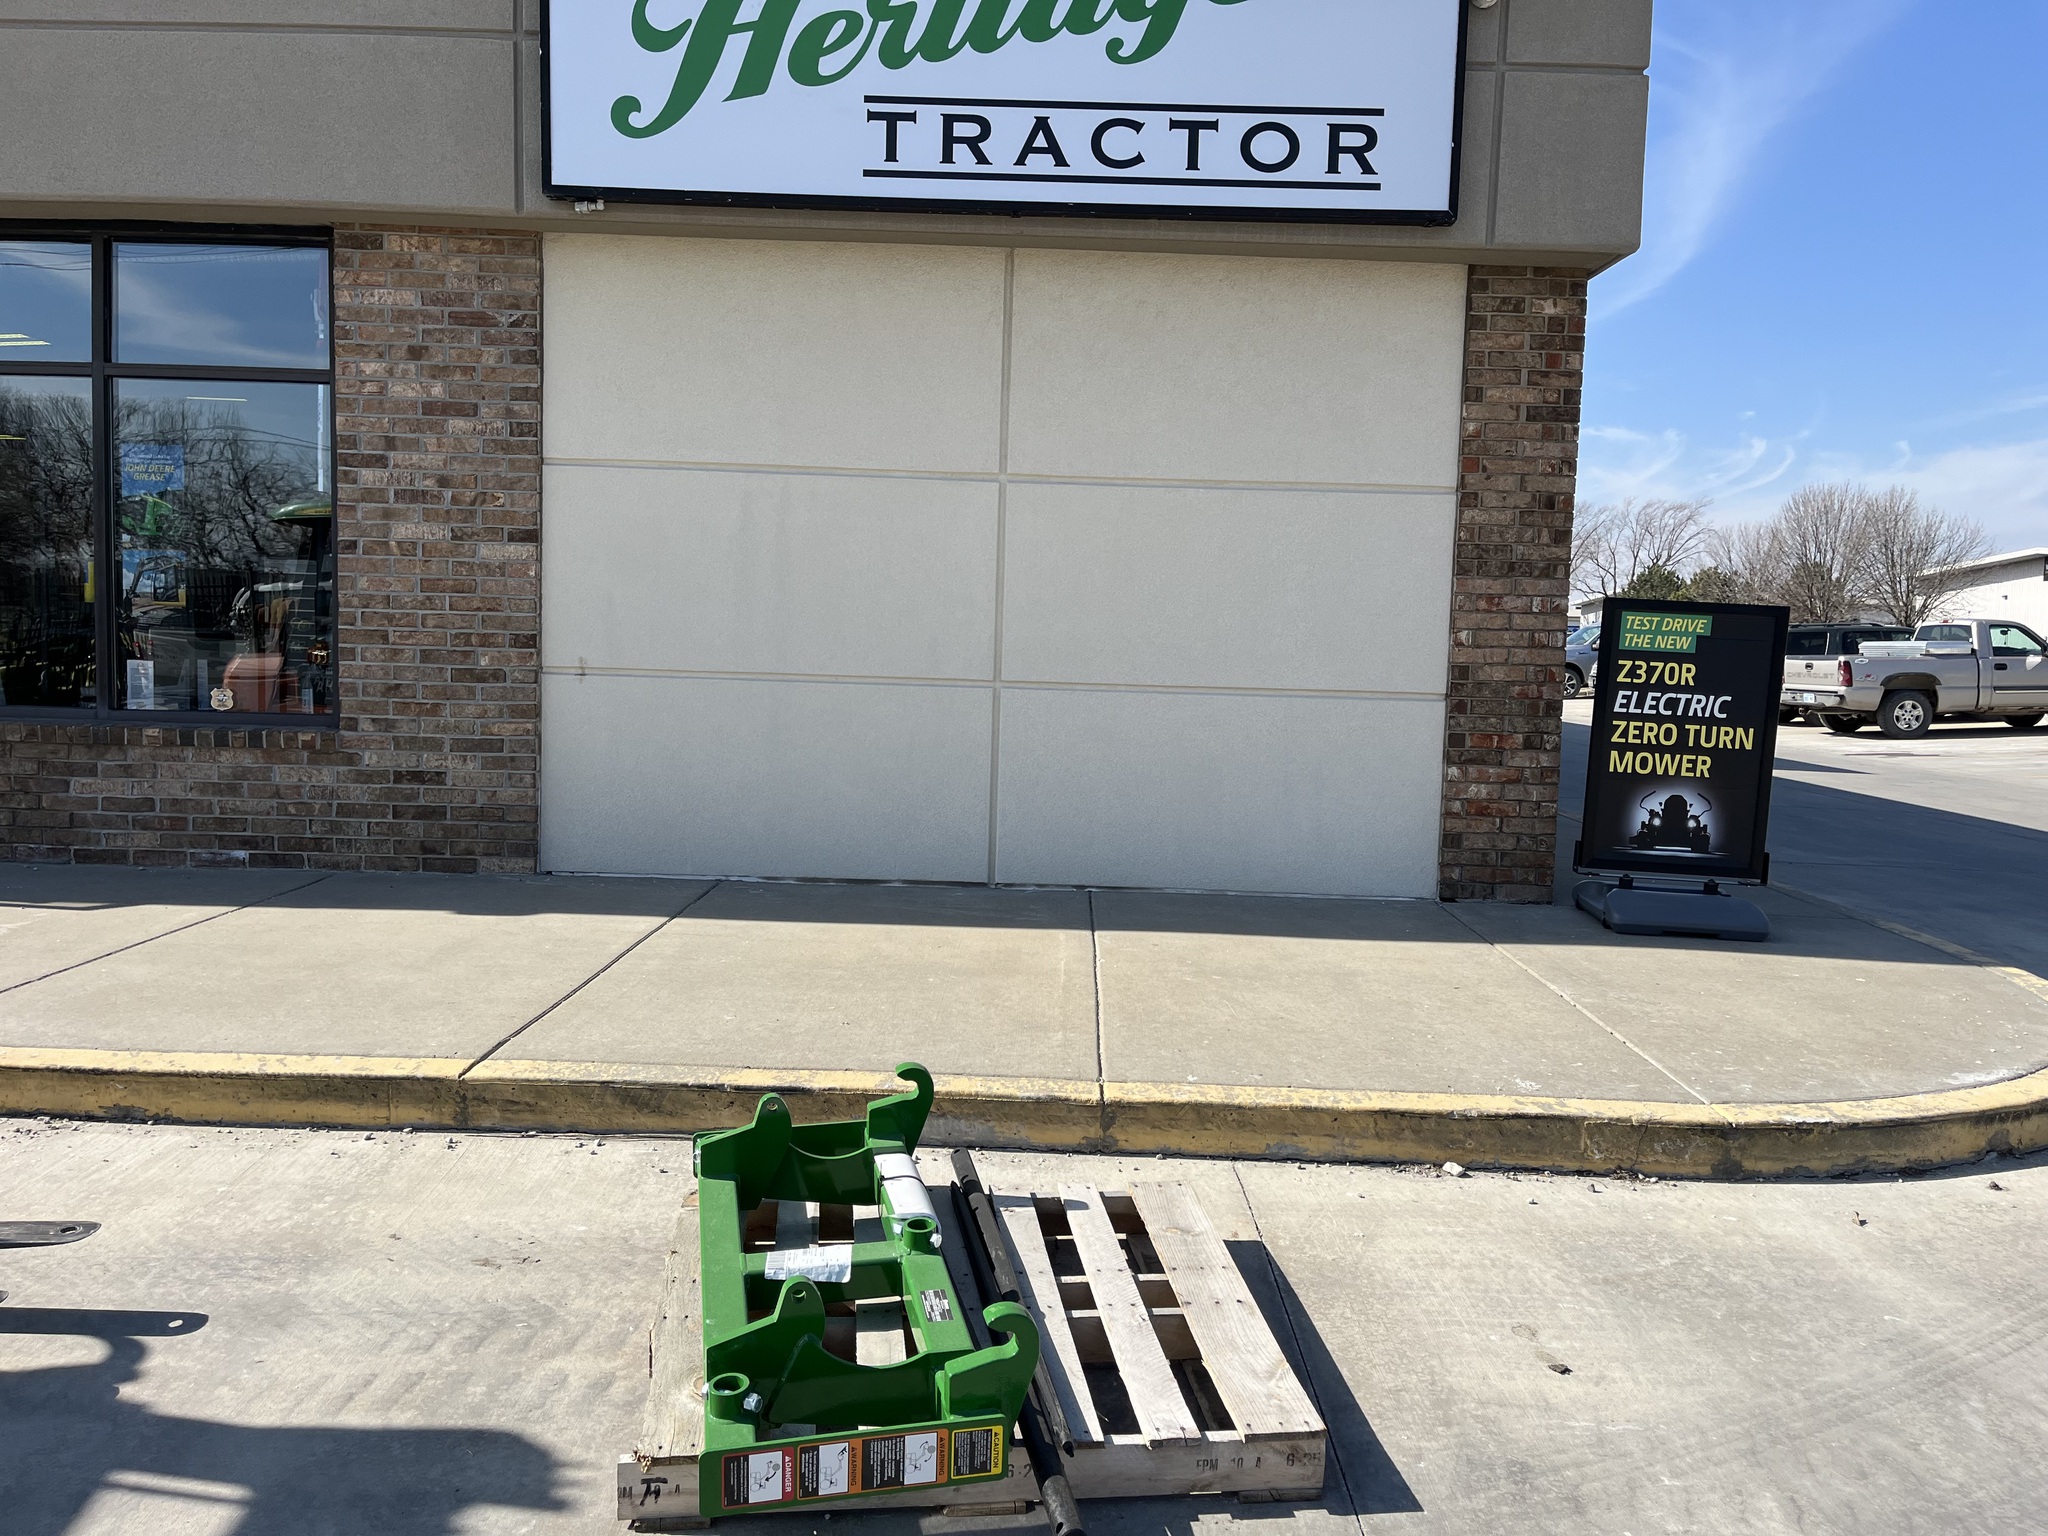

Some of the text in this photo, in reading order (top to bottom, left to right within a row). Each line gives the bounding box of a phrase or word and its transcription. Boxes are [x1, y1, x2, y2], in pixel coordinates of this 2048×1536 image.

[866, 109, 1380, 176] TRACTOR
[133, 473, 166, 481] GREASE
[148, 464, 176, 473] DEERE
[1625, 615, 1707, 633] TEST DRIVE
[1624, 634, 1692, 650] THE NEW
[1616, 660, 1697, 686] Z370R
[1613, 690, 1732, 719] ELECTRIC
[1610, 720, 1755, 750] ZERO TURN
[1608, 751, 1712, 778] MOWER
